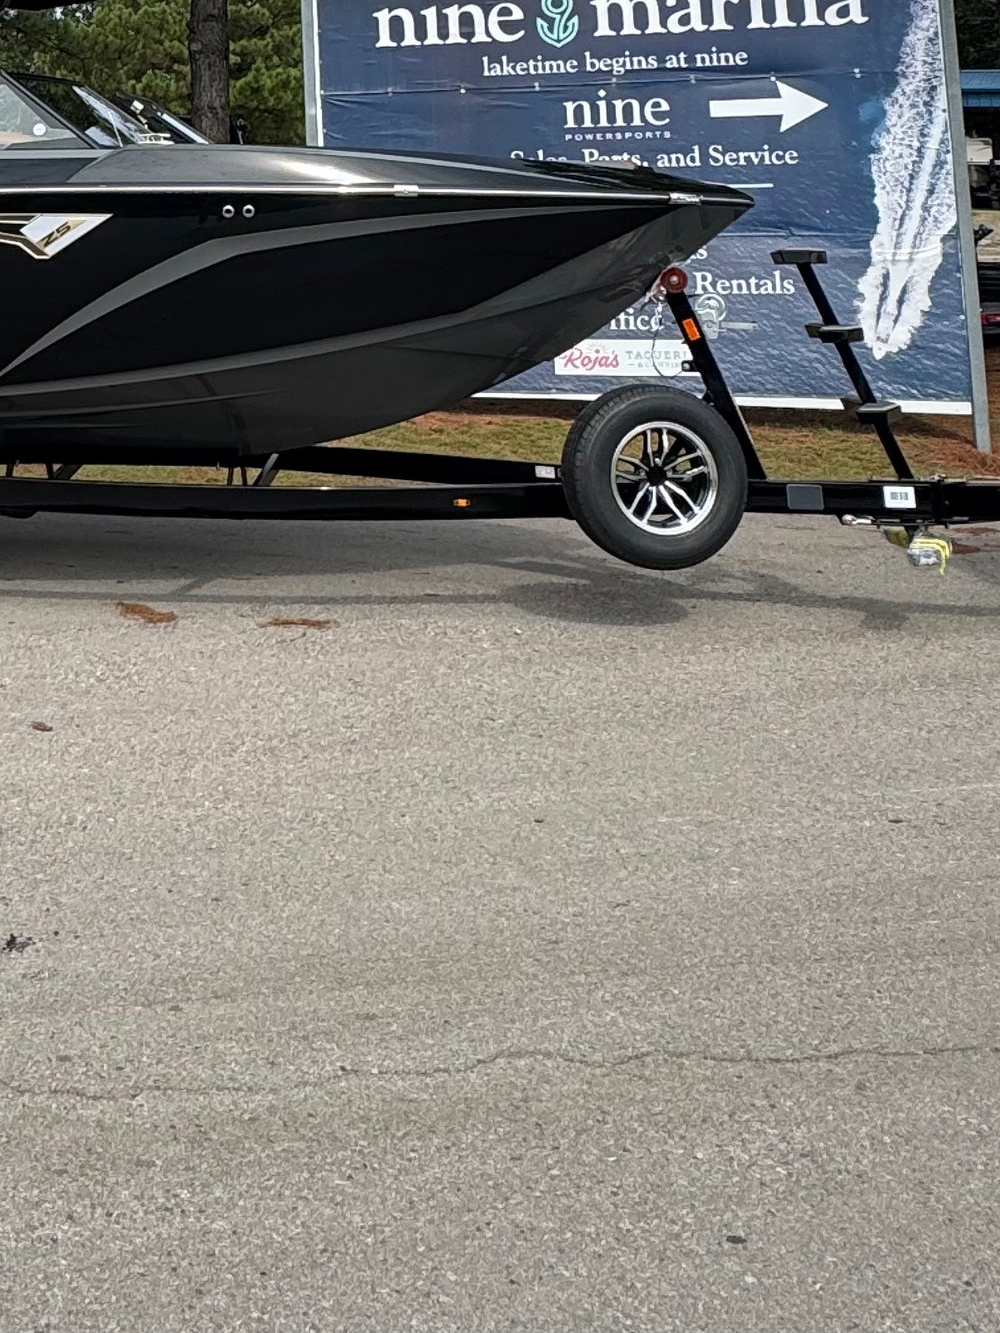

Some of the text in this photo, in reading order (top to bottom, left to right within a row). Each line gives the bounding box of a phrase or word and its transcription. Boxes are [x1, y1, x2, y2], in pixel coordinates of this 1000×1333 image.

[482, 46, 748, 77] laketime begins at nine
[562, 89, 671, 128] nine
[564, 130, 672, 141] POWERSPORTS
[656, 144, 702, 168] and
[708, 144, 799, 167] Service
[692, 270, 796, 295] Rentals
